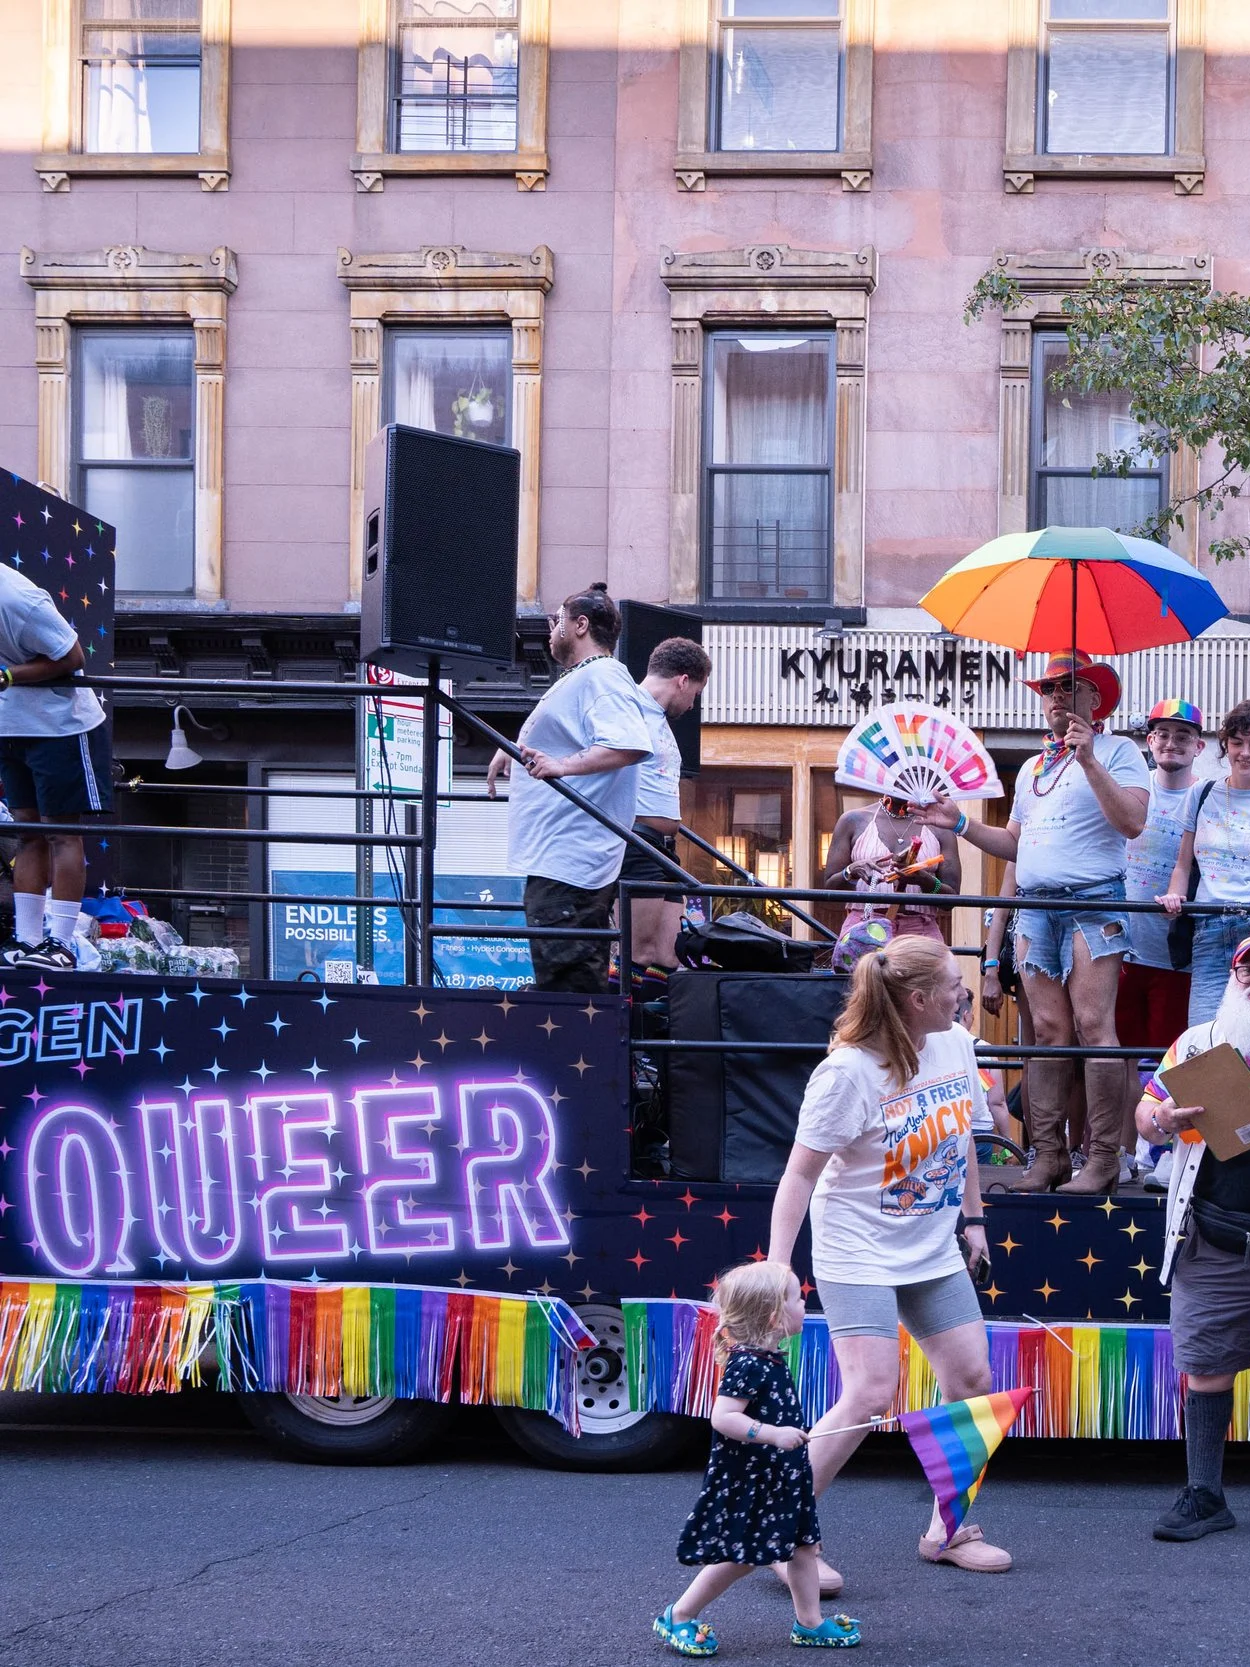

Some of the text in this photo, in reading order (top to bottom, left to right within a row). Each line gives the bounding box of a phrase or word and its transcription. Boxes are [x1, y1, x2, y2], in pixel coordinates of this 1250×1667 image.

[781, 649, 1010, 681] KYURAMEN
[397, 737, 421, 747] parking
[893, 714, 988, 791] KIND
[397, 752, 412, 762] 7pm
[400, 763, 424, 773] Sunda
[285, 905, 388, 926] ENDLES
[285, 927, 391, 942] POSSIBILIES.
[441, 944, 465, 952] Fitness
[496, 946, 529, 954] Concepts
[469, 974, 534, 990] 768-7788
[884, 1097, 912, 1120] HOT
[930, 1080, 969, 1104] FRESH
[906, 1106, 928, 1133] York
[880, 1098, 974, 1189] KNICKS
[26, 1081, 570, 1275] QUEER
